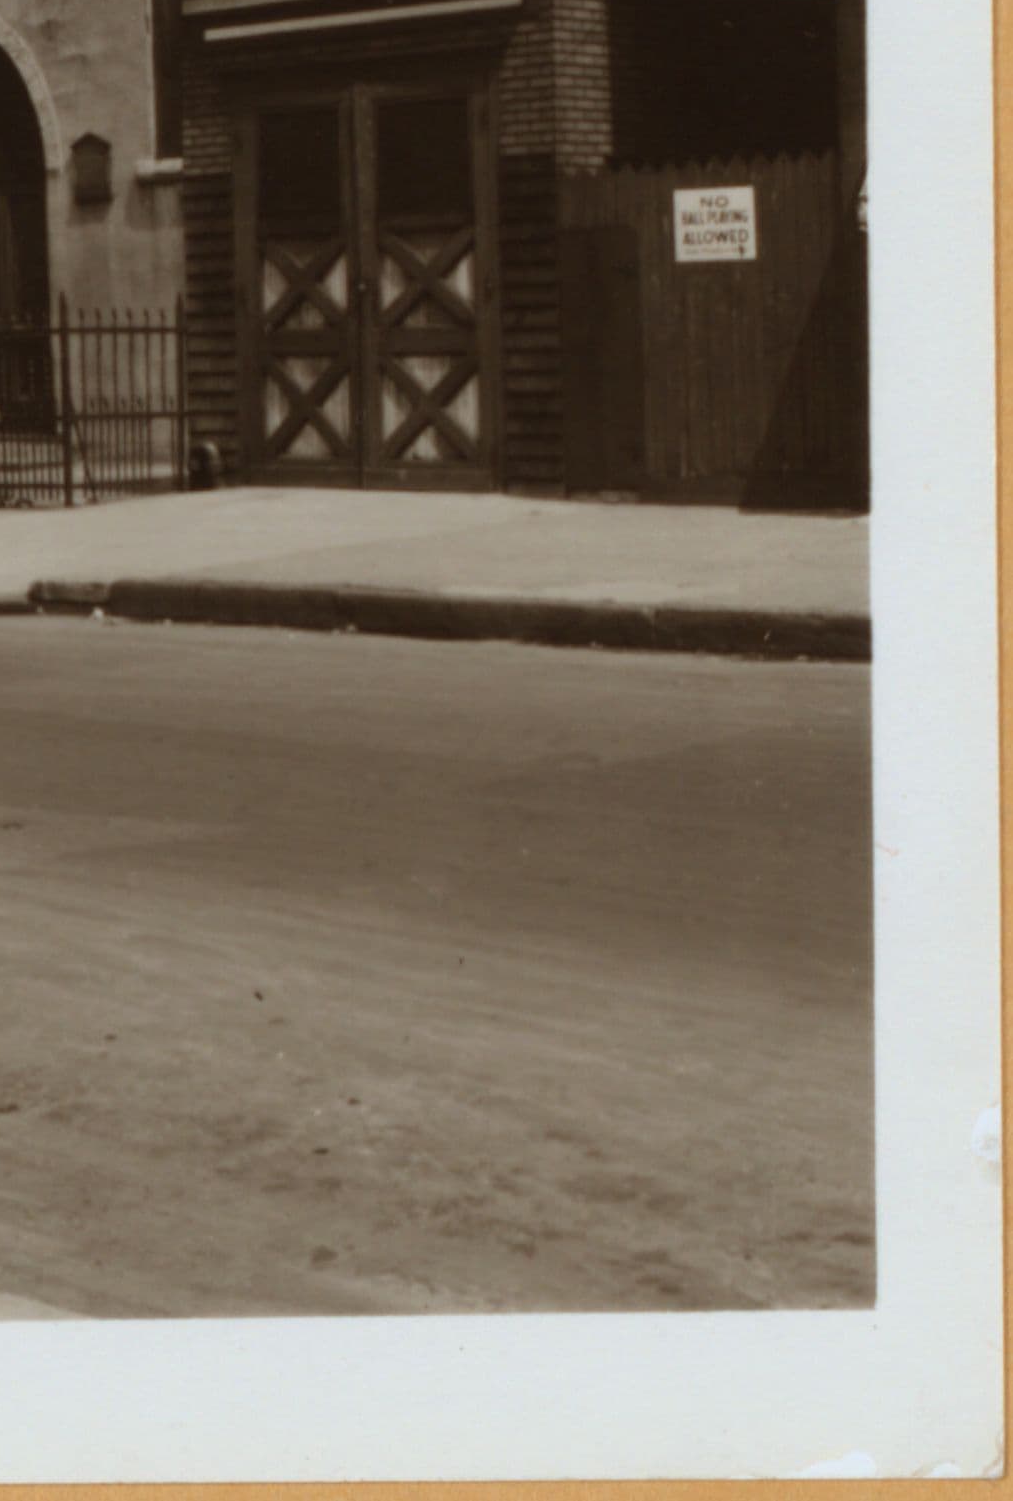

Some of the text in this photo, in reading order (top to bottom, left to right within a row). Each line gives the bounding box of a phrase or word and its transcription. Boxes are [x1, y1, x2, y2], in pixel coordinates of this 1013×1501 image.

[700, 196, 729, 208] NO
[682, 210, 748, 225] BALL PLAYING
[683, 229, 749, 244] ALLOWED
